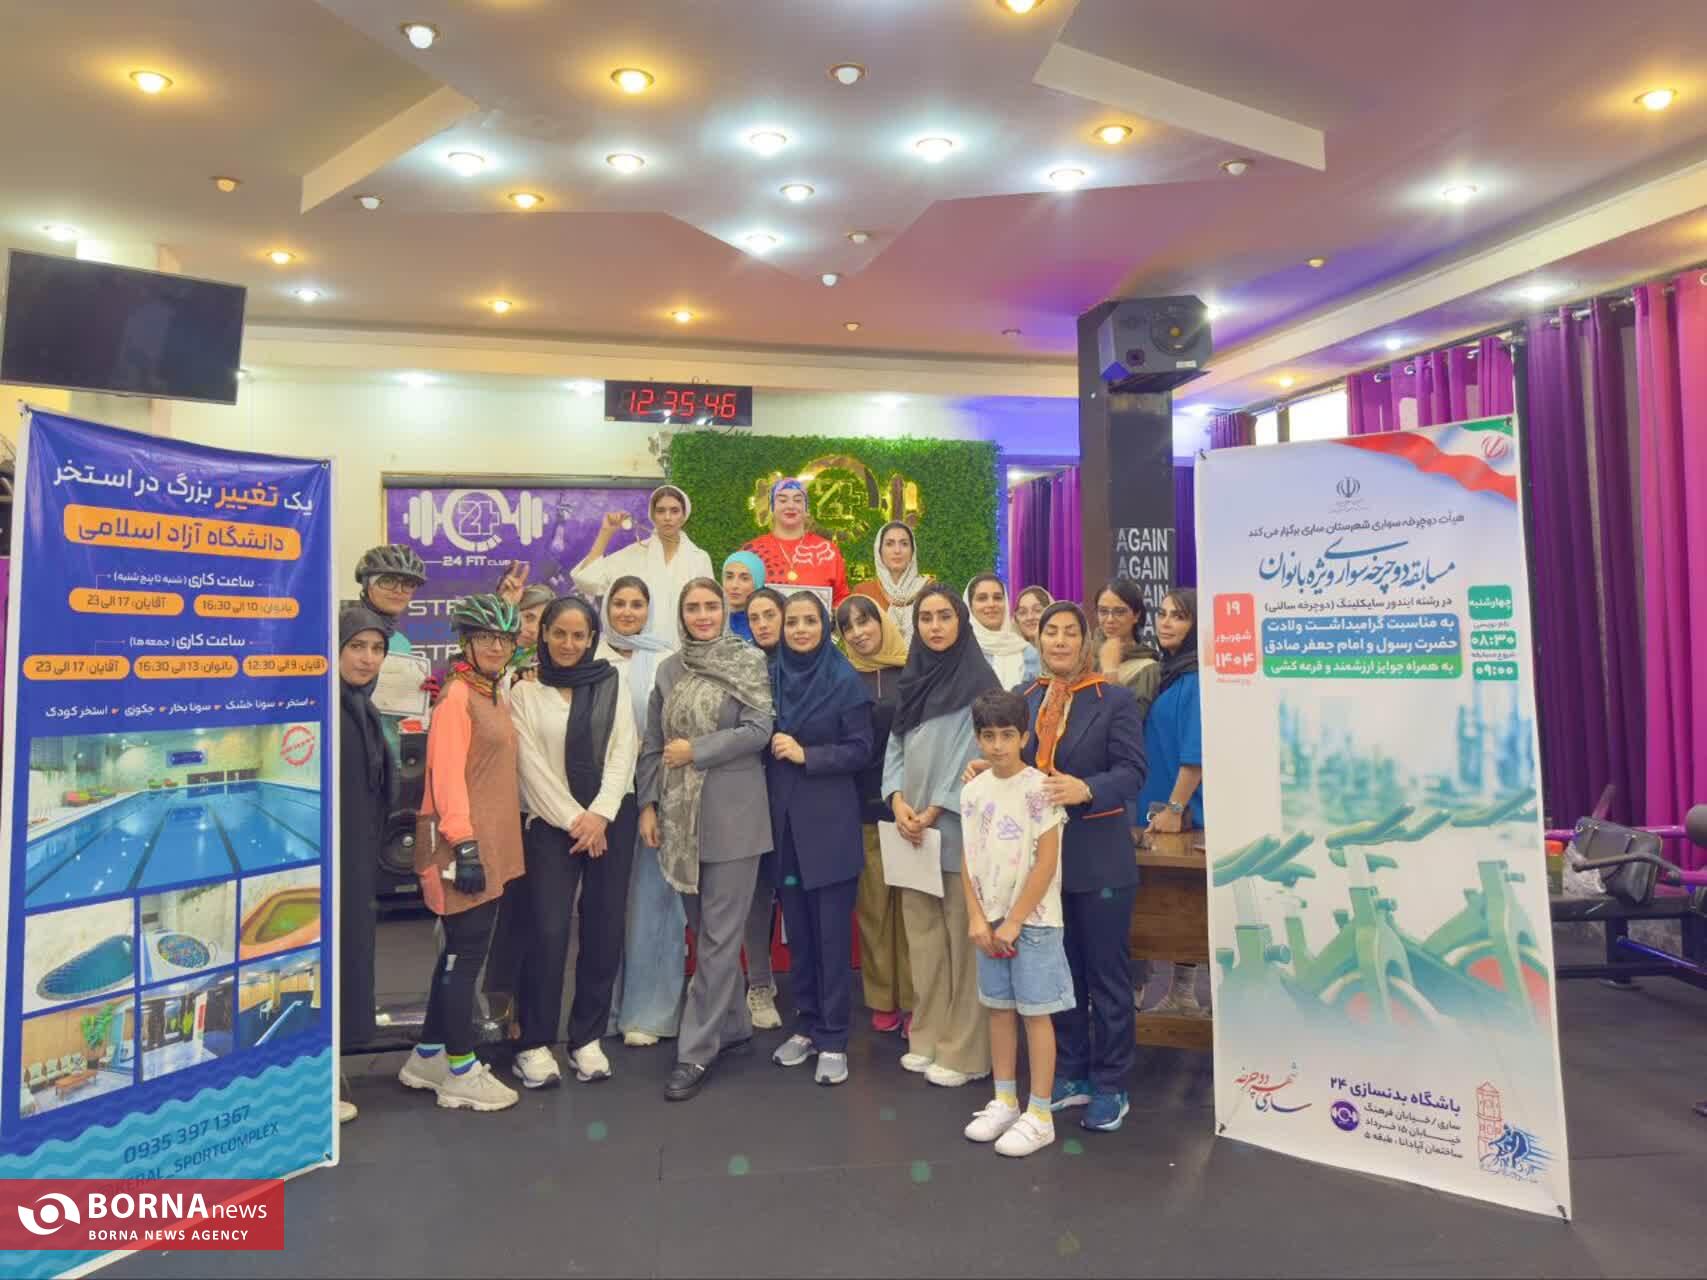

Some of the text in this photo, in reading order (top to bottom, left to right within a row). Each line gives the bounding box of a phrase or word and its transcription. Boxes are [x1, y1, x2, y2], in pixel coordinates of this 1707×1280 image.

[629, 389, 737, 419] 12 35 46
[53, 459, 314, 516] یک تغییر بزرگ در استخر
[1326, 519, 1370, 534] شهرستان
[78, 517, 284, 552] دانشگاه آزاد اسلامی
[1116, 528, 1168, 552] AGAIN
[442, 555, 461, 567] 24
[466, 555, 487, 567] FIT
[1117, 556, 1169, 580] AGAIN
[188, 573, 214, 589] کاری
[217, 575, 255, 588] ساعت
[87, 594, 100, 606] 23
[118, 596, 130, 607] 17
[202, 600, 231, 611] 16:30
[1226, 600, 1241, 616] ۱۹
[1267, 620, 1303, 634] ولادت
[1387, 615, 1439, 631] مناسبت
[1440, 618, 1455, 629] به
[176, 633, 203, 649] کاری
[206, 634, 246, 647] ساعت
[1265, 639, 1300, 655] صادق
[1337, 640, 1364, 654] امام
[1376, 638, 1412, 654] رسول
[1415, 636, 1458, 652] حضرت
[1472, 634, 1514, 646] ۰۸:۳۰
[1301, 641, 1335, 655] جعفر
[35, 661, 52, 672] 23
[73, 661, 85, 672] 17
[1215, 652, 1255, 668] ۱۴۰۴
[1406, 660, 1439, 672] همراه
[1270, 661, 1297, 674] کشی
[1298, 662, 1323, 674] قرعه
[1333, 661, 1375, 674] ارزشمند
[1376, 661, 1405, 674] جوایز
[1441, 663, 1454, 672] به
[1475, 663, 1513, 676] ۰۹:۰۰
[45, 705, 78, 719] کودک
[78, 704, 108, 718] استخر
[1330, 1077, 1461, 1117] باشگاه بدنسازی ۲۴
[123, 1104, 250, 1164] 0935 397 1367
